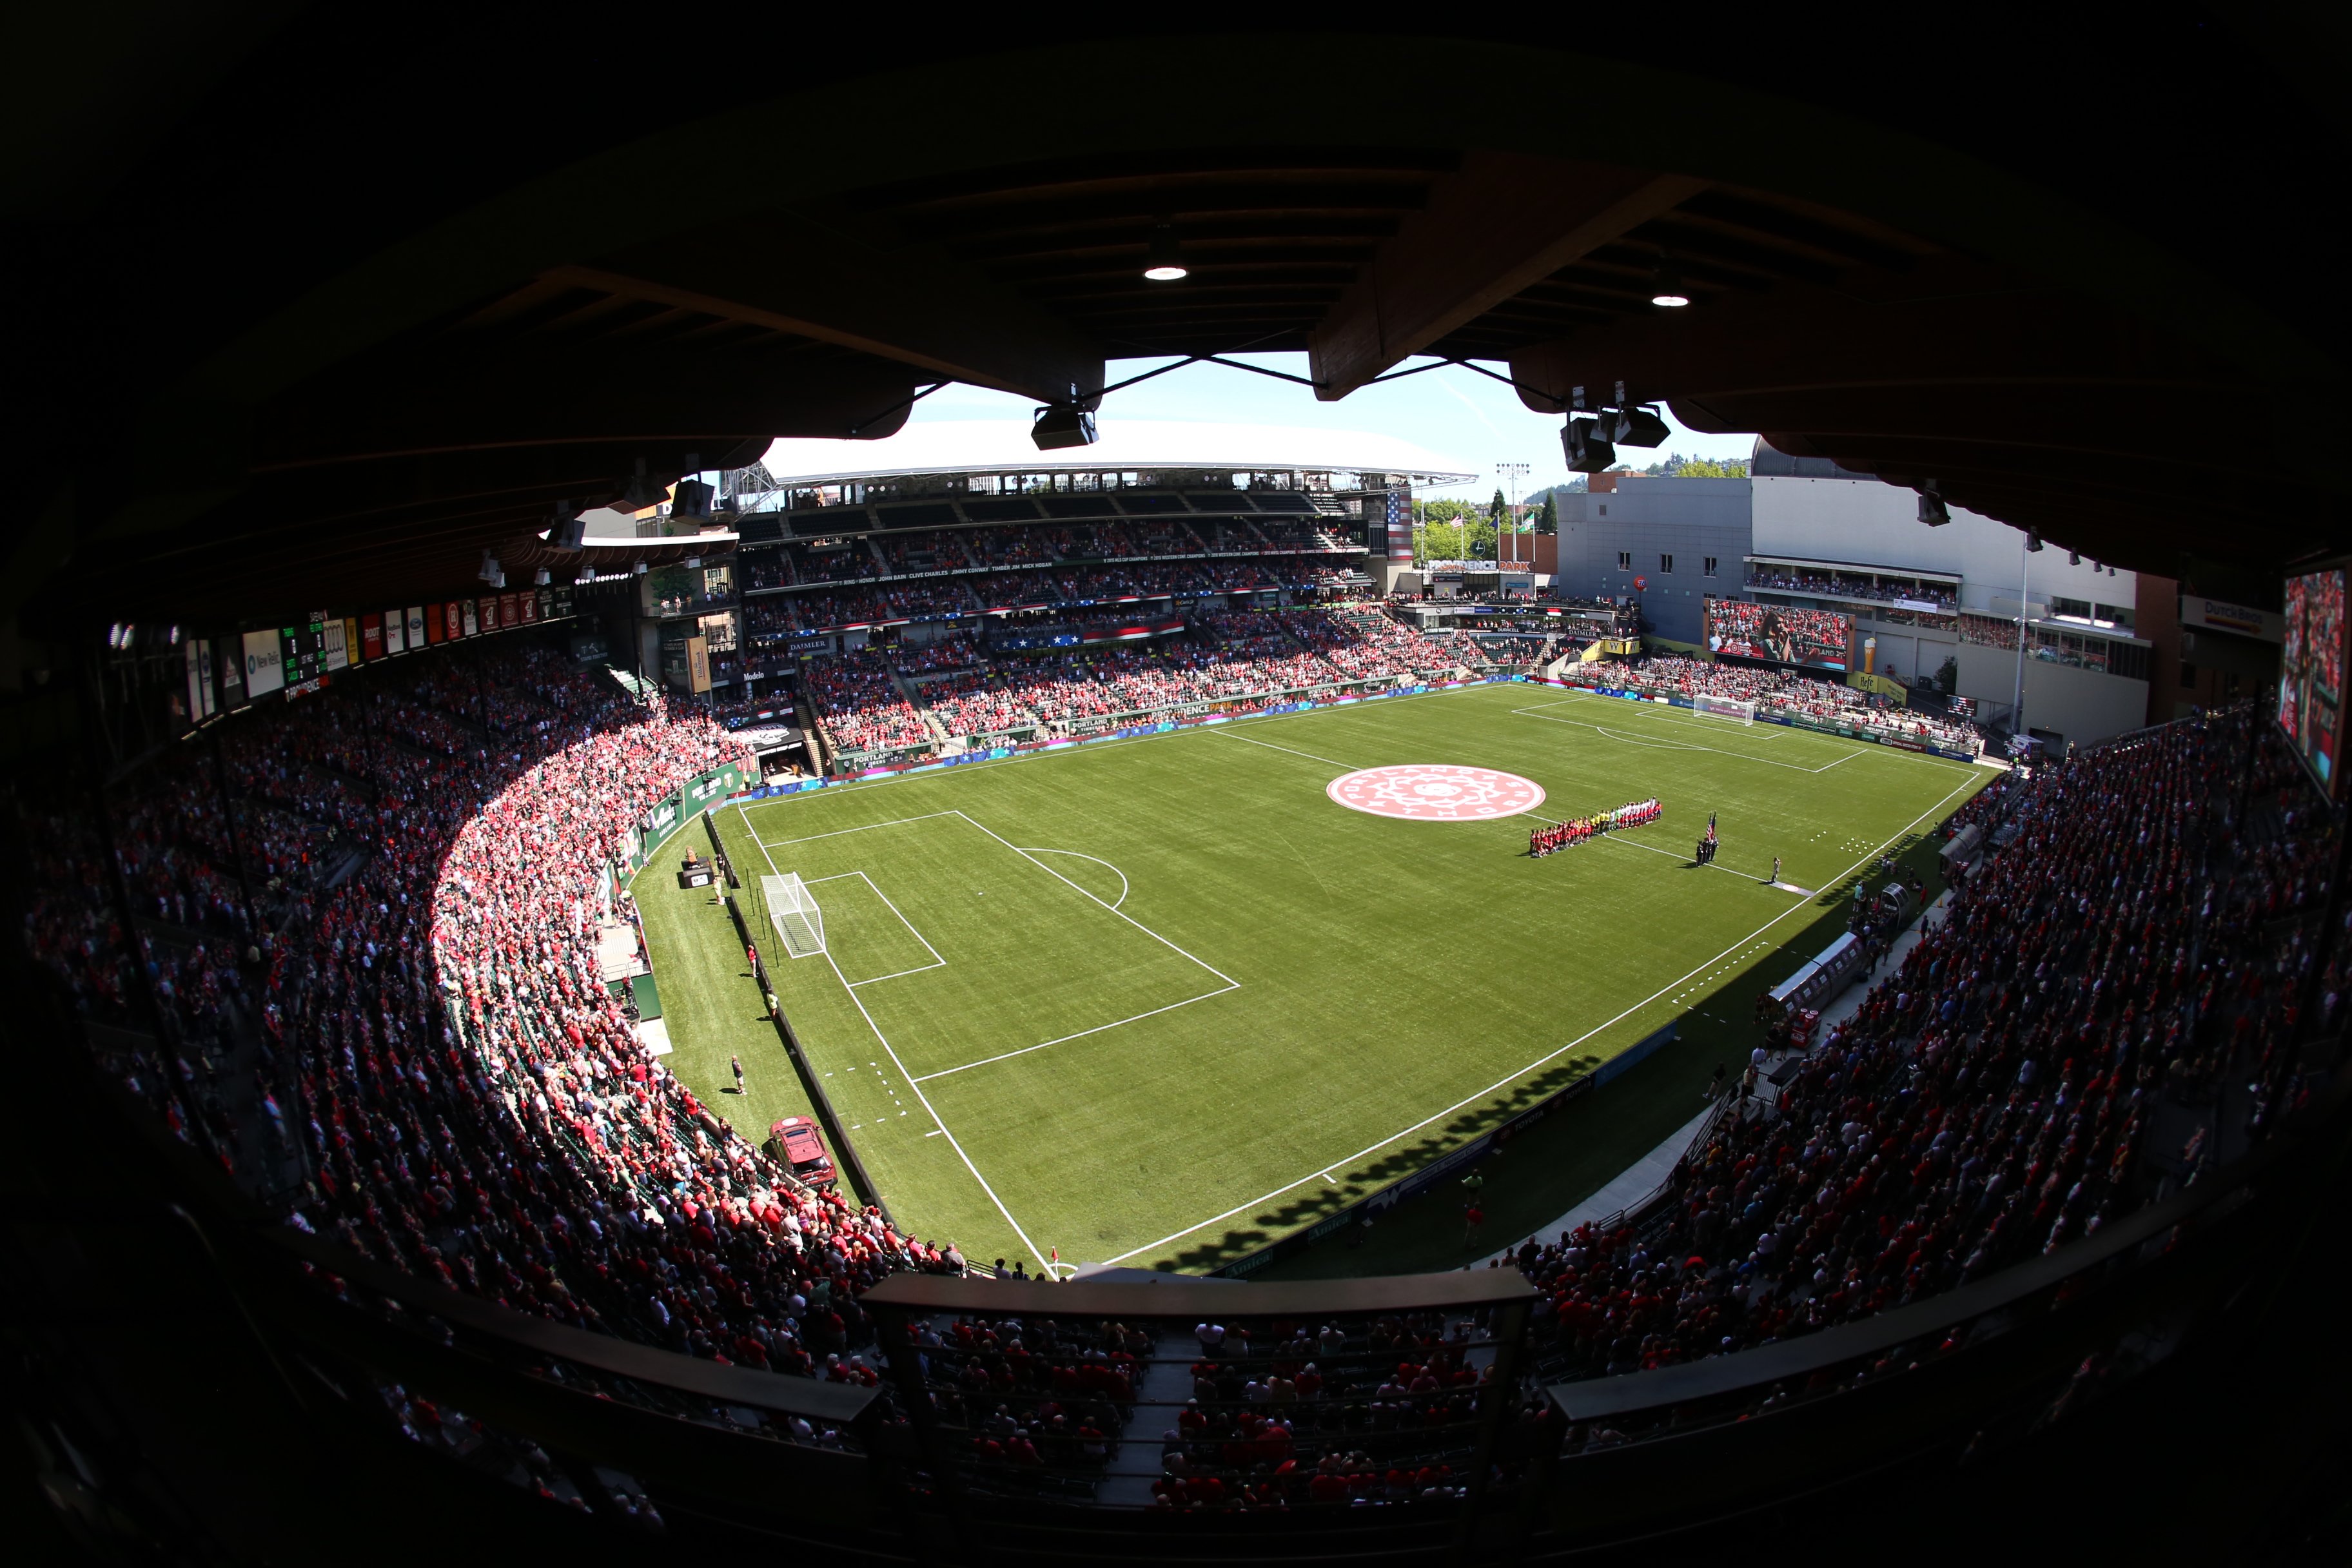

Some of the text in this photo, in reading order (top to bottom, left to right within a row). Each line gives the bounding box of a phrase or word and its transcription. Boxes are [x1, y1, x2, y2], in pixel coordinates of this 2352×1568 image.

[1428, 560, 1530, 571] PROVIDENCE PARK
[1637, 579, 1645, 587] 76
[364, 627, 380, 639] ROOT
[790, 641, 826, 651] DAIMLER
[1609, 642, 1619, 651] W
[257, 656, 268, 669] New
[744, 671, 764, 681] Modelo
[1860, 676, 1874, 690] Hefe
[1152, 701, 1234, 720] PROVIDENCE PARK
[1073, 718, 1108, 729] PORTLAND
[853, 752, 893, 764] PORTLAND
[1344, 767, 1475, 800] PORTLAND
[1403, 781, 1530, 817] THORNS
[659, 819, 676, 838] AIRLINES
[1565, 1081, 1592, 1101] TOYOTA
[1515, 1110, 1544, 1131] TOYOTA
[1417, 1168, 1436, 1181] Walter
[1444, 1152, 1464, 1167] Nelson
[1312, 1216, 1349, 1238] Amica
[1230, 1253, 1270, 1277] Amica
